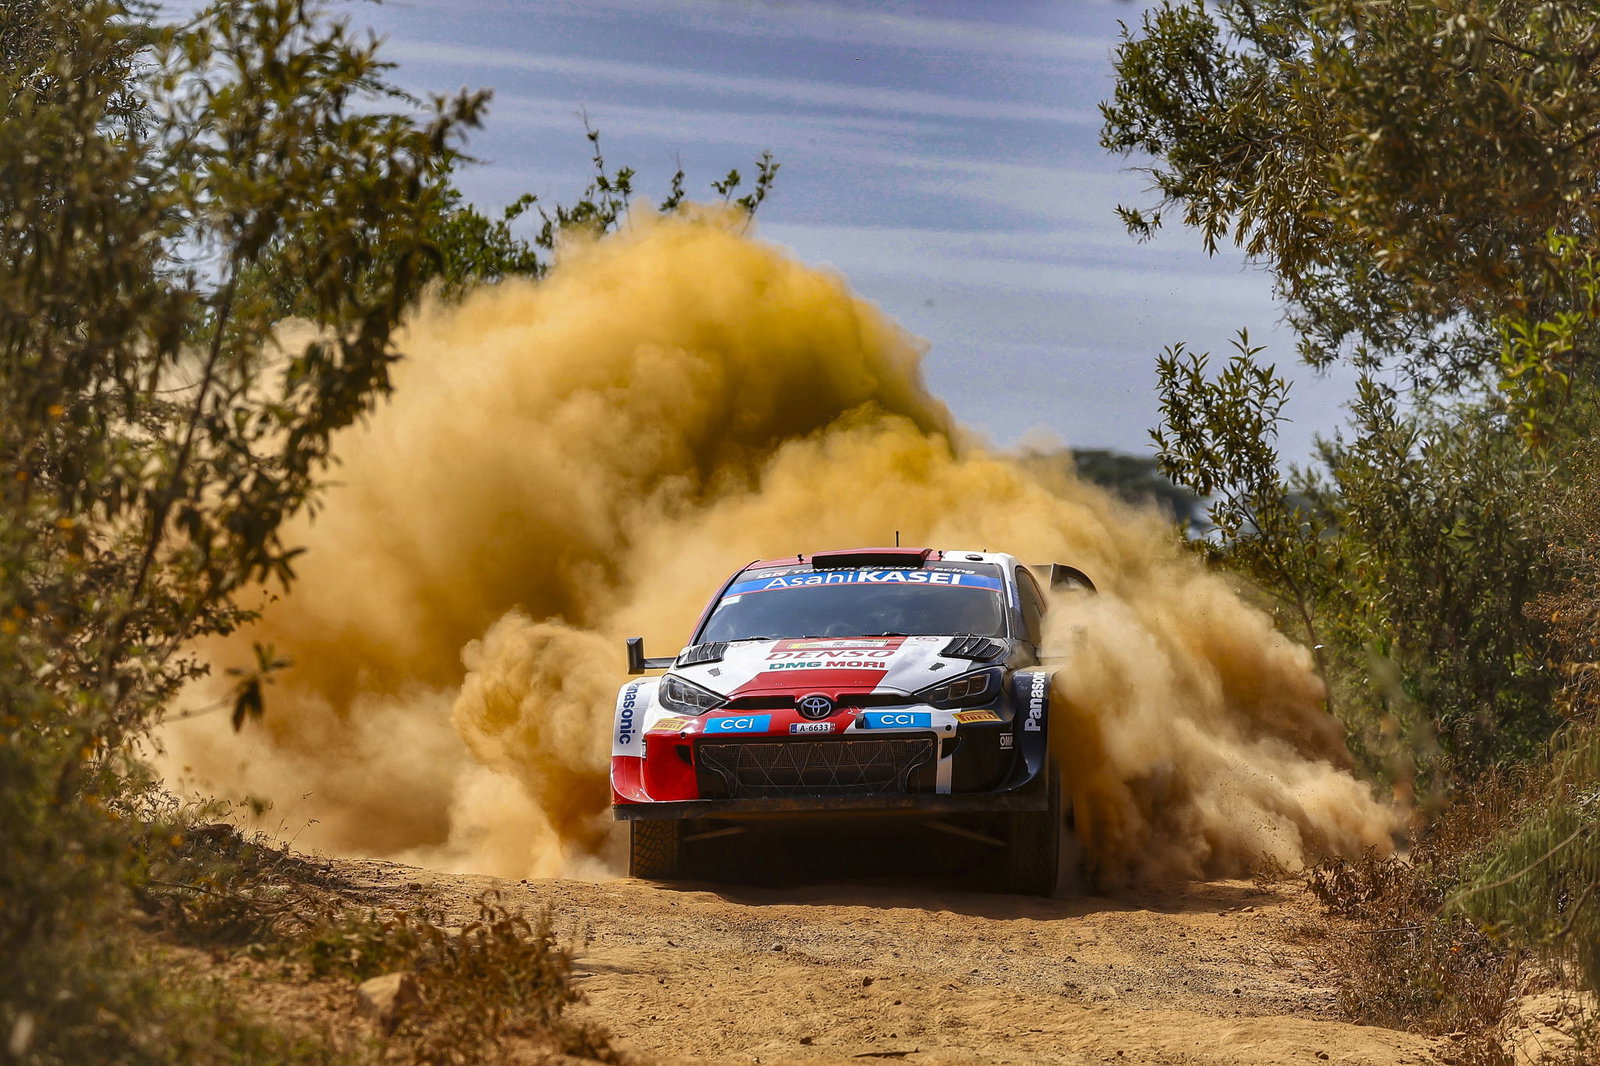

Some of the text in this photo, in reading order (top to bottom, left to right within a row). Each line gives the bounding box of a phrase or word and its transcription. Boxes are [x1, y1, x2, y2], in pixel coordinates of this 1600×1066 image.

[922, 566, 976, 575] Racing
[765, 650, 895, 660] DENSO
[769, 660, 886, 670] DMG MORI
[880, 714, 914, 725] CCI
[799, 724, 829, 732] A-6633
